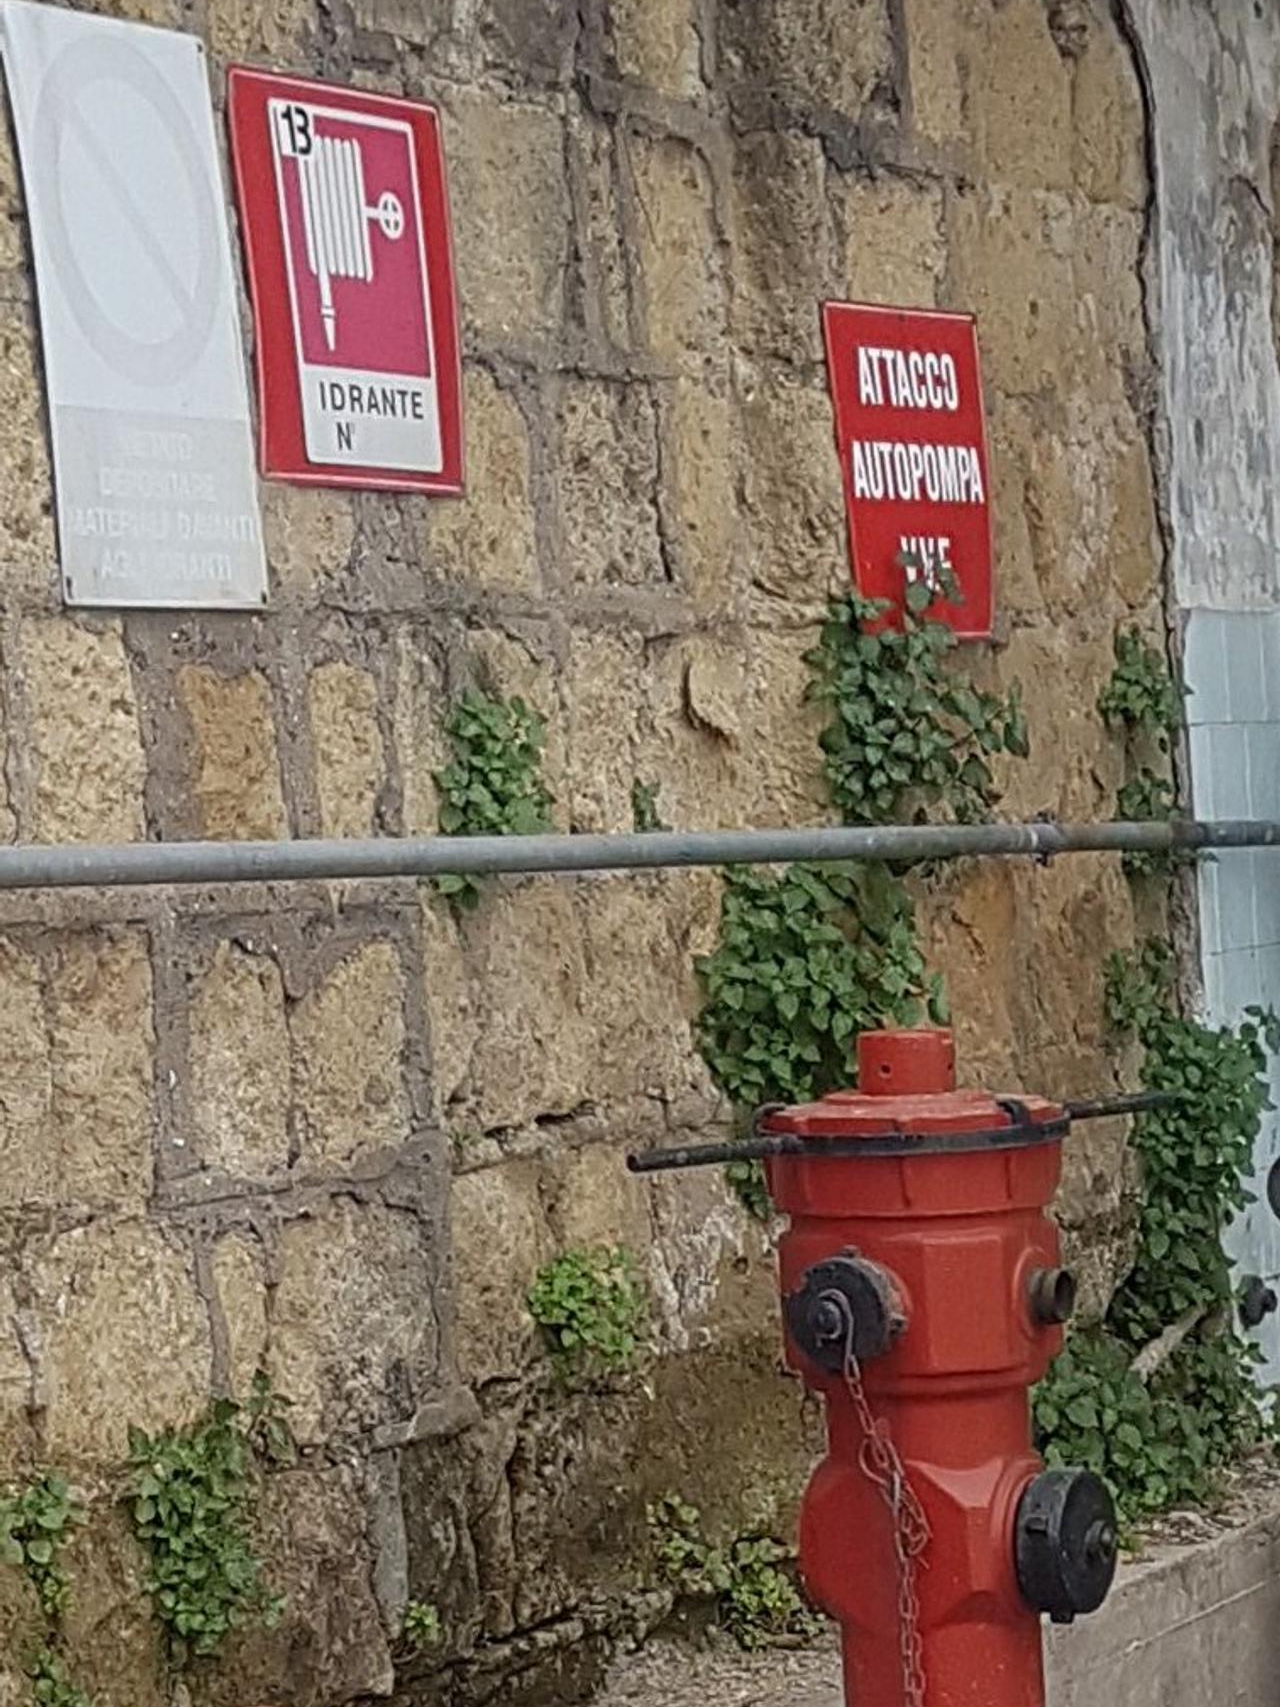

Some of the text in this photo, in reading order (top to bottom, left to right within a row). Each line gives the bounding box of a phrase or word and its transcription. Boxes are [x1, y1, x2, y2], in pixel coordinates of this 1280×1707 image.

[281, 104, 312, 155] 13
[319, 381, 425, 420] IDRANTE
[857, 346, 959, 411] ATTACCO
[852, 440, 986, 505] AUTOPOMPA
